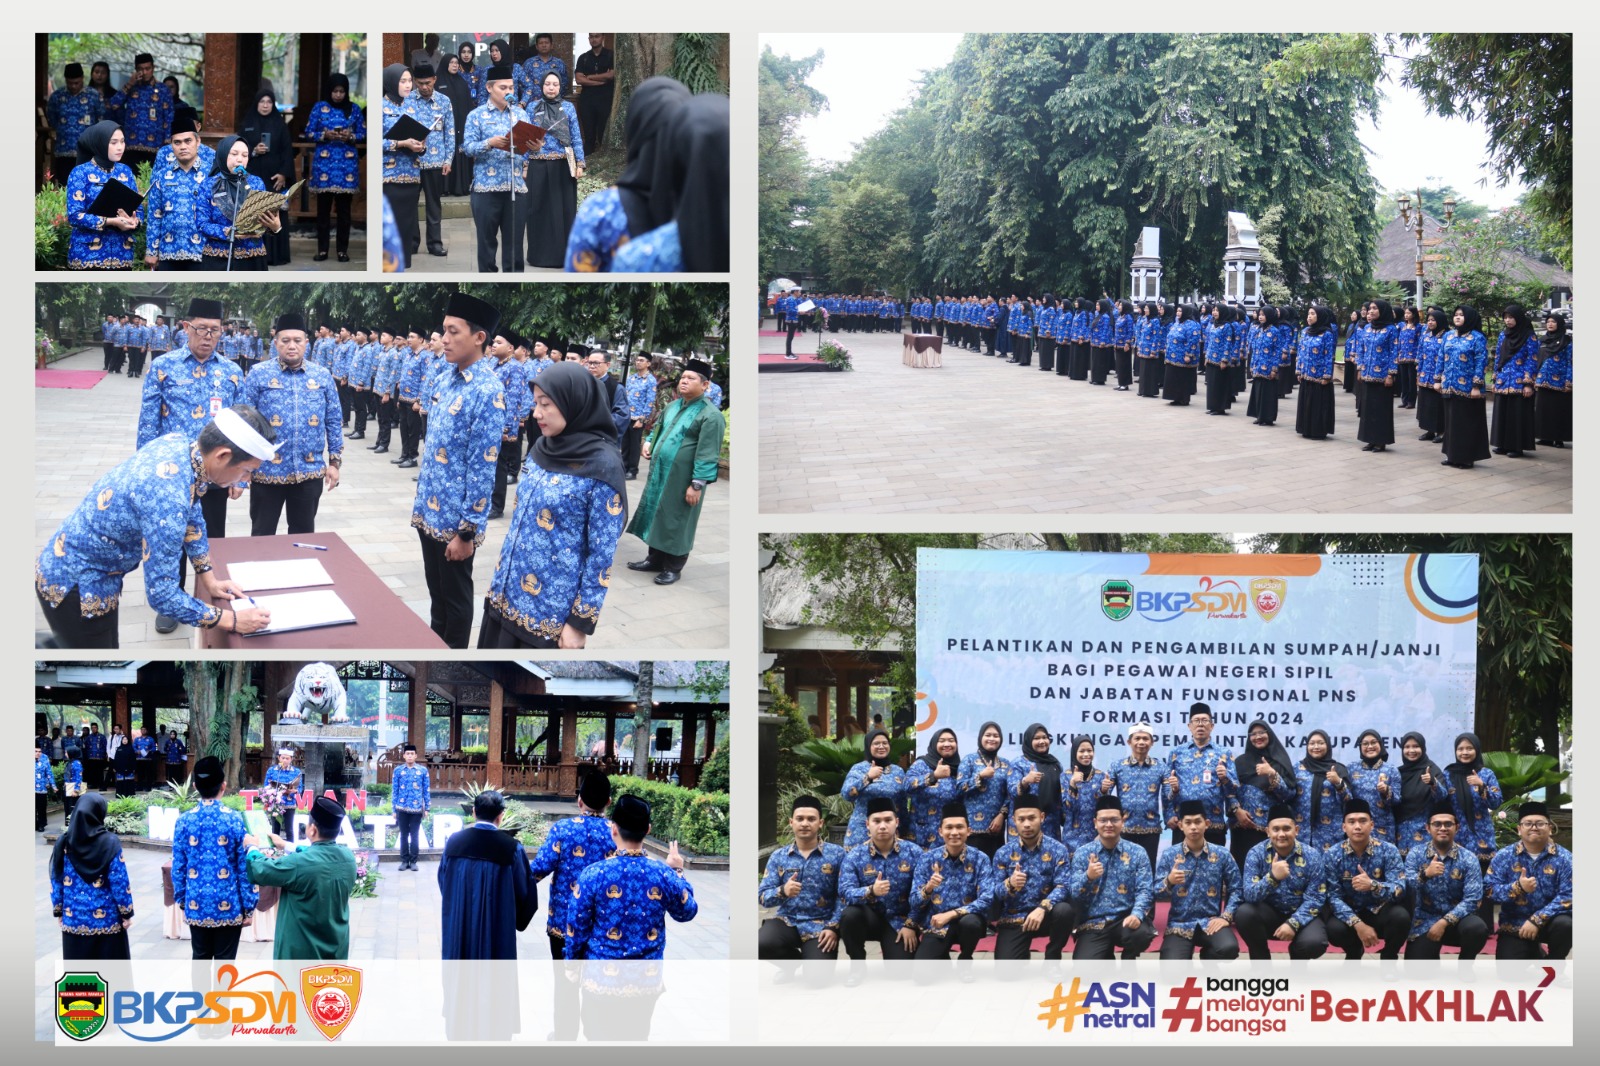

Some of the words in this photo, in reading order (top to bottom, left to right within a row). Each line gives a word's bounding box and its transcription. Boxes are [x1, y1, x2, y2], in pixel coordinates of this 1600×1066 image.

[1136, 590, 1247, 612] BKPSDM
[947, 638, 1073, 653] PELANTIKAN
[1081, 640, 1123, 654] DAN
[1131, 641, 1276, 655] PENGAMBILAN
[1284, 639, 1441, 659] SUMPAH/JANJI
[1047, 663, 1096, 677] BAGI
[1104, 664, 1197, 678] PEGAWAI
[1205, 665, 1276, 679] NEGERI
[1284, 666, 1334, 680] SIPIL
[1030, 686, 1072, 700] DAN
[1079, 687, 1174, 701] JABATAN
[1182, 688, 1310, 703] FUNGSIONAL
[1318, 689, 1357, 703] PNS
[1081, 710, 1171, 724] FORMASI
[1179, 711, 1248, 725] THUN
[1255, 712, 1304, 726] 2024
[239, 789, 368, 812] TMAN
